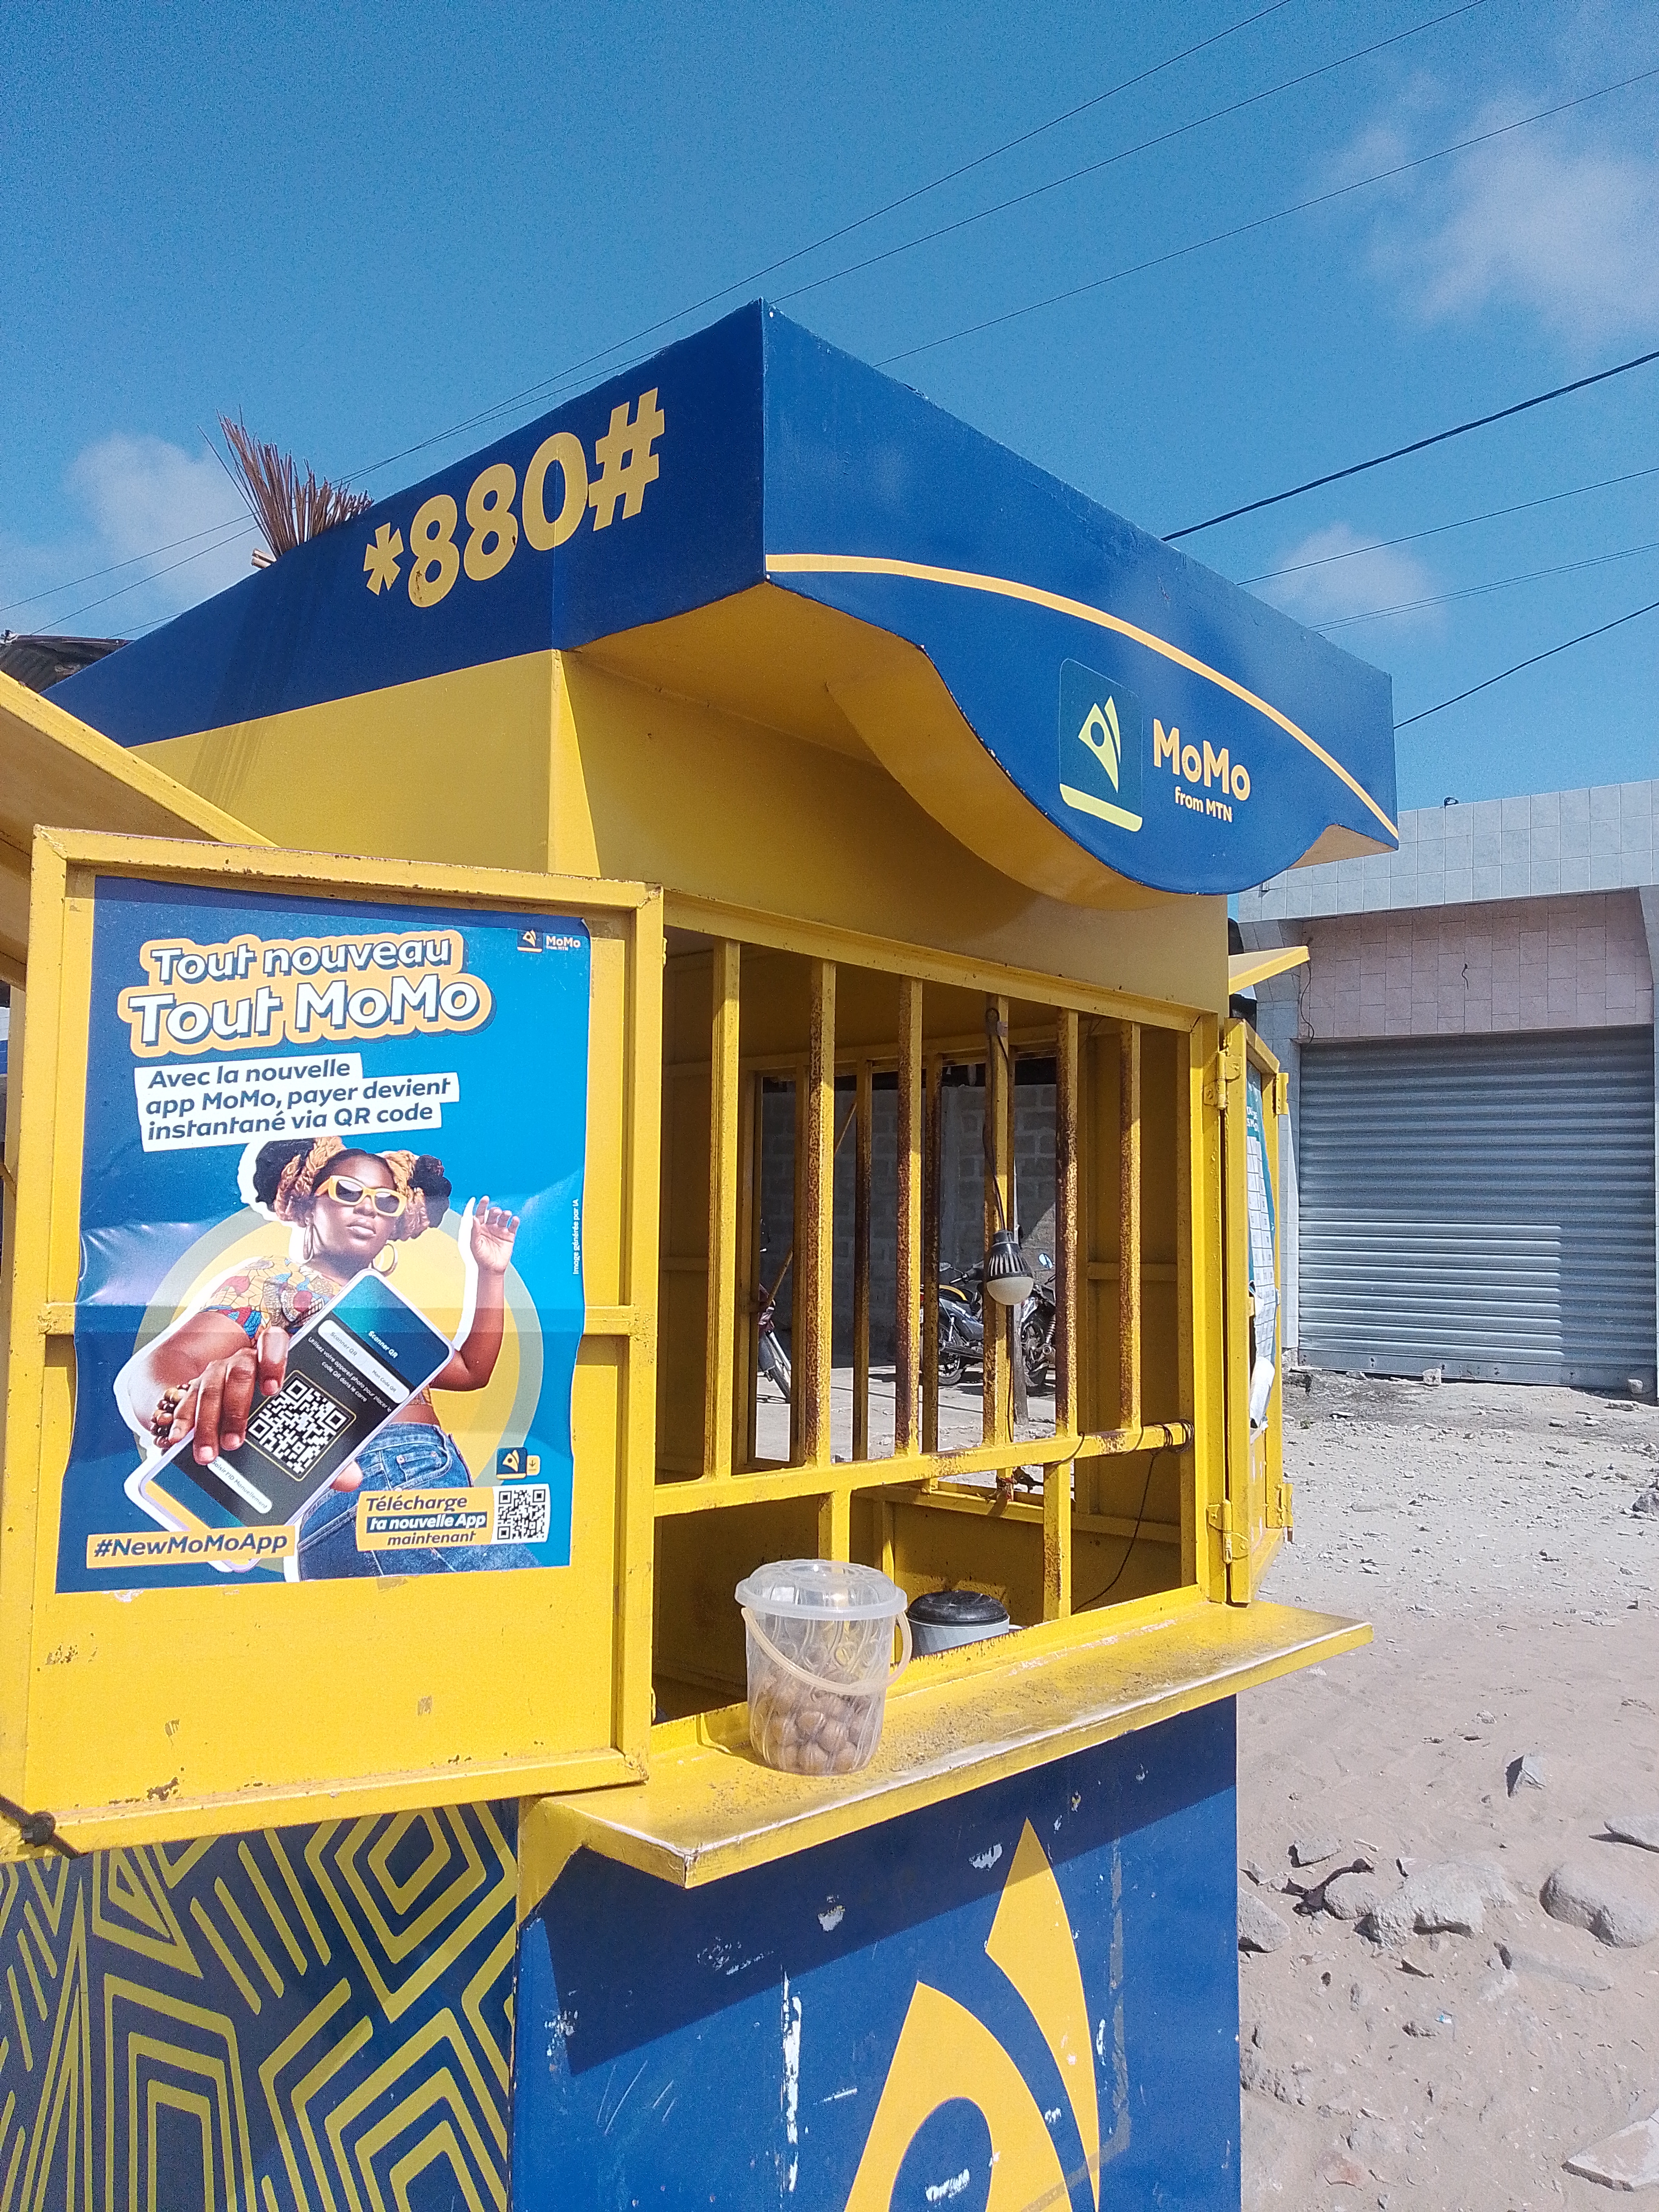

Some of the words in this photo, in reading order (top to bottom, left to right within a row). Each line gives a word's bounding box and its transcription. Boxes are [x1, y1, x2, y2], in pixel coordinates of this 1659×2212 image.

[1153, 718, 1251, 801] MoMo
[1175, 786, 1204, 812] from
[1206, 798, 1233, 823] MTN
[546, 935, 581, 948] MoMo
[152, 944, 255, 983] Tout
[264, 938, 451, 973] nouveau
[129, 987, 282, 1046] Tout
[295, 974, 479, 1030] MoMo
[147, 1069, 211, 1090] Avec
[216, 1065, 242, 1085] la
[246, 1059, 350, 1083] nouvelle
[145, 1096, 195, 1119] app
[202, 1089, 282, 1111] MoMo,
[287, 1086, 358, 1110] payer
[363, 1078, 451, 1100] devient
[148, 1111, 286, 1141] instantané
[291, 1113, 327, 1129] via
[334, 1107, 371, 1127] QR
[376, 1102, 433, 1123] code
[330, 1331, 349, 1350] Scanner
[348, 1347, 358, 1356] QR
[368, 1330, 389, 1351] Scanner
[388, 1348, 398, 1359] QR
[308, 1337, 324, 1353] Utilisez
[323, 1350, 336, 1363] votre
[334, 1361, 355, 1378] appareil
[350, 1376, 365, 1389] photo
[363, 1387, 375, 1397] pour
[373, 1395, 389, 1409] placer
[321, 1361, 334, 1373] code
[332, 1370, 342, 1380] QR
[339, 1377, 351, 1389] dans
[372, 1370, 381, 1379] Mon
[380, 1377, 390, 1387] Code
[234, 1479, 268, 1509] Manuellement
[366, 1495, 467, 1512] Télécharge
[370, 1519, 389, 1530] ta
[389, 1513, 453, 1529] nouvelle
[455, 1513, 486, 1529] App
[94, 1532, 288, 1558] #NewMoMoApp
[387, 1530, 477, 1546] maintenant
